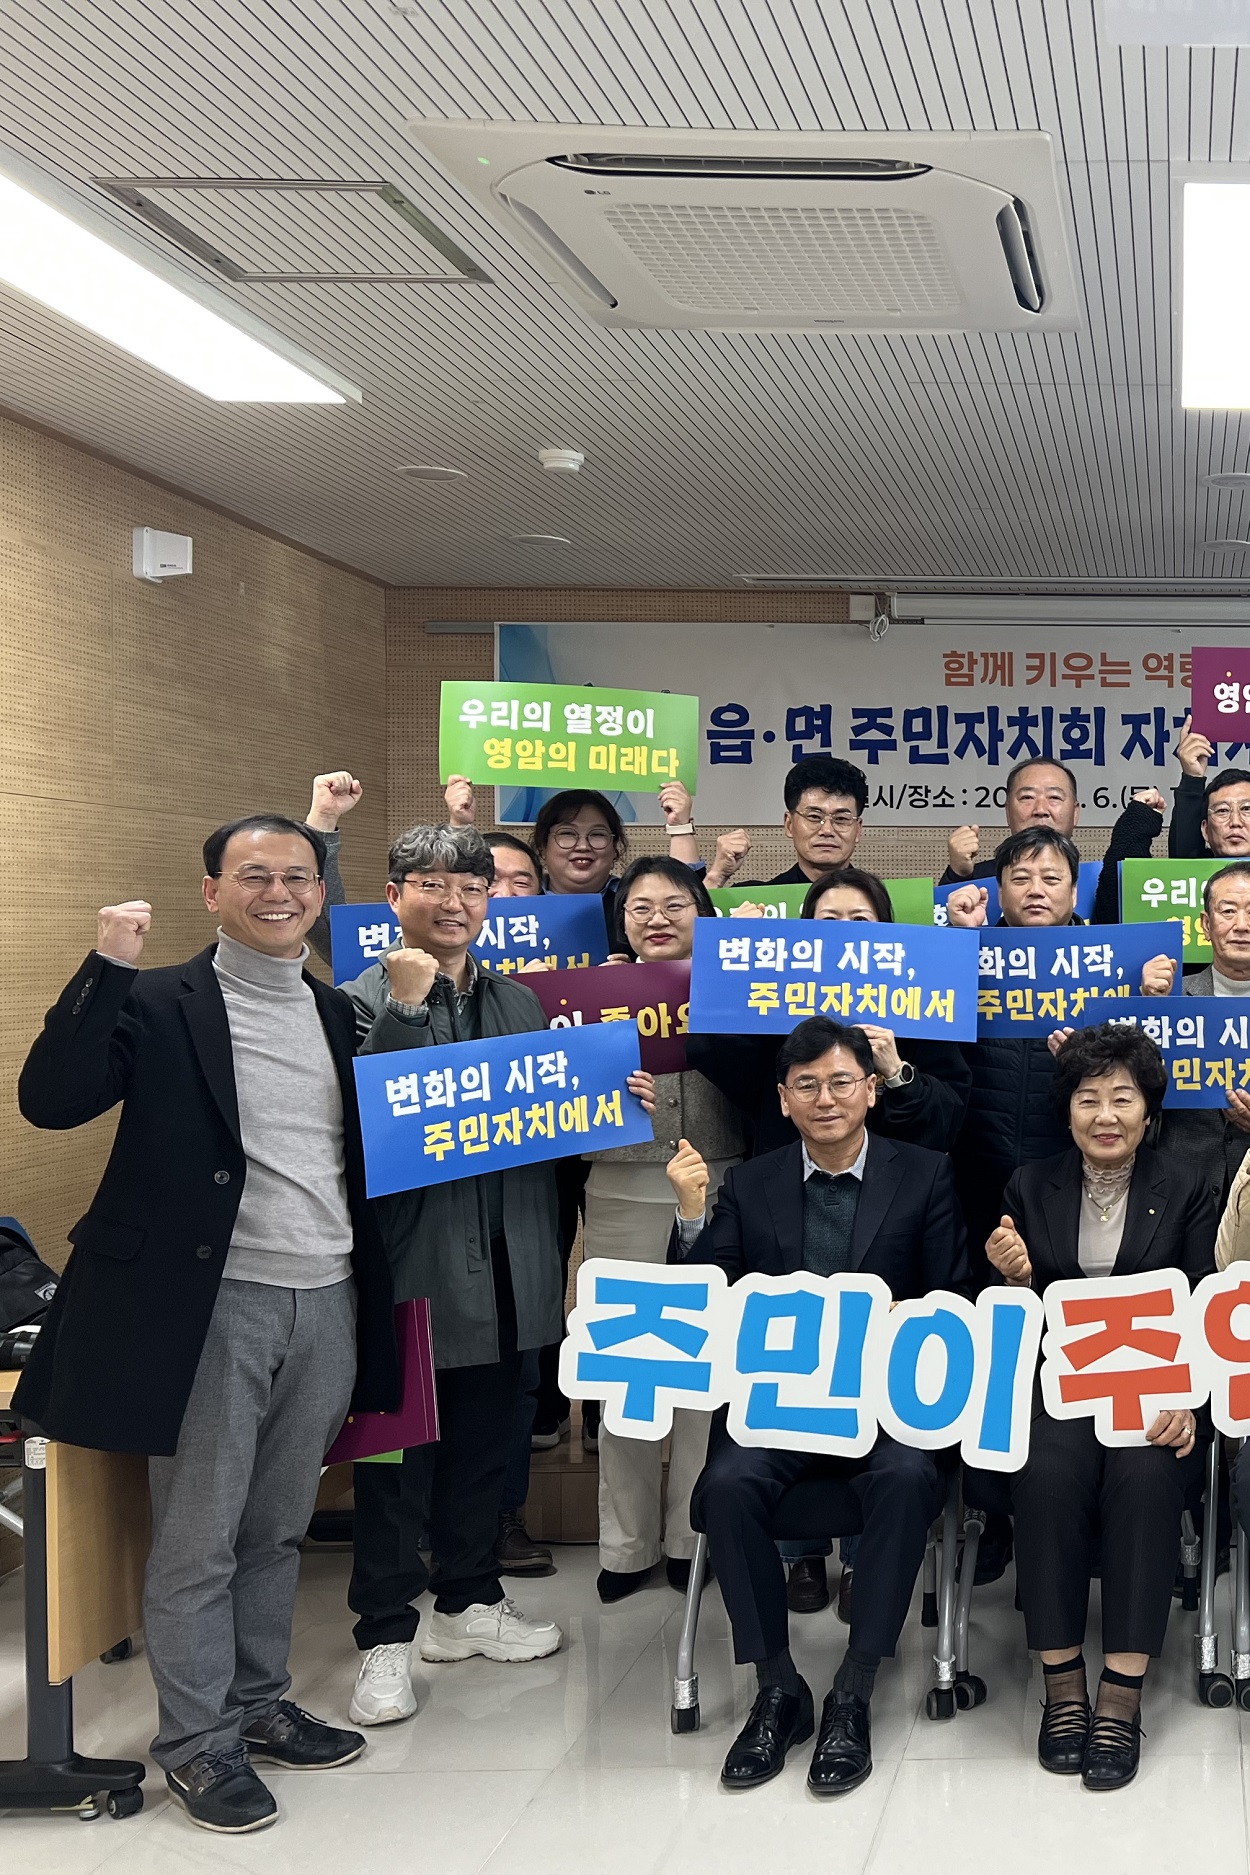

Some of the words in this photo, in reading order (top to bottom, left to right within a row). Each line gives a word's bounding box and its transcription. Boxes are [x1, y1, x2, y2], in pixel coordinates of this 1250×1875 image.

[942, 650, 1014, 688] 함께
[1025, 651, 1132, 689] 키우는
[458, 699, 552, 732] 우리의
[563, 702, 655, 738] 열정이
[849, 704, 1106, 767] 주민자치회
[483, 738, 577, 772] 영암의
[588, 743, 680, 777] 미래다
[864, 784, 955, 809] 시/장소
[475, 914, 550, 951] 시작,
[718, 937, 824, 972] 변화의
[837, 940, 916, 981] 시작,
[978, 945, 1037, 980] 화의
[1049, 944, 1124, 980] 시작,
[747, 981, 956, 1023] 주민자치에서
[385, 1062, 491, 1117] 변화의
[504, 1050, 580, 1095] 시작,
[422, 1089, 625, 1162] 주민자치에서
[577, 1276, 1026, 1453] 주민이
